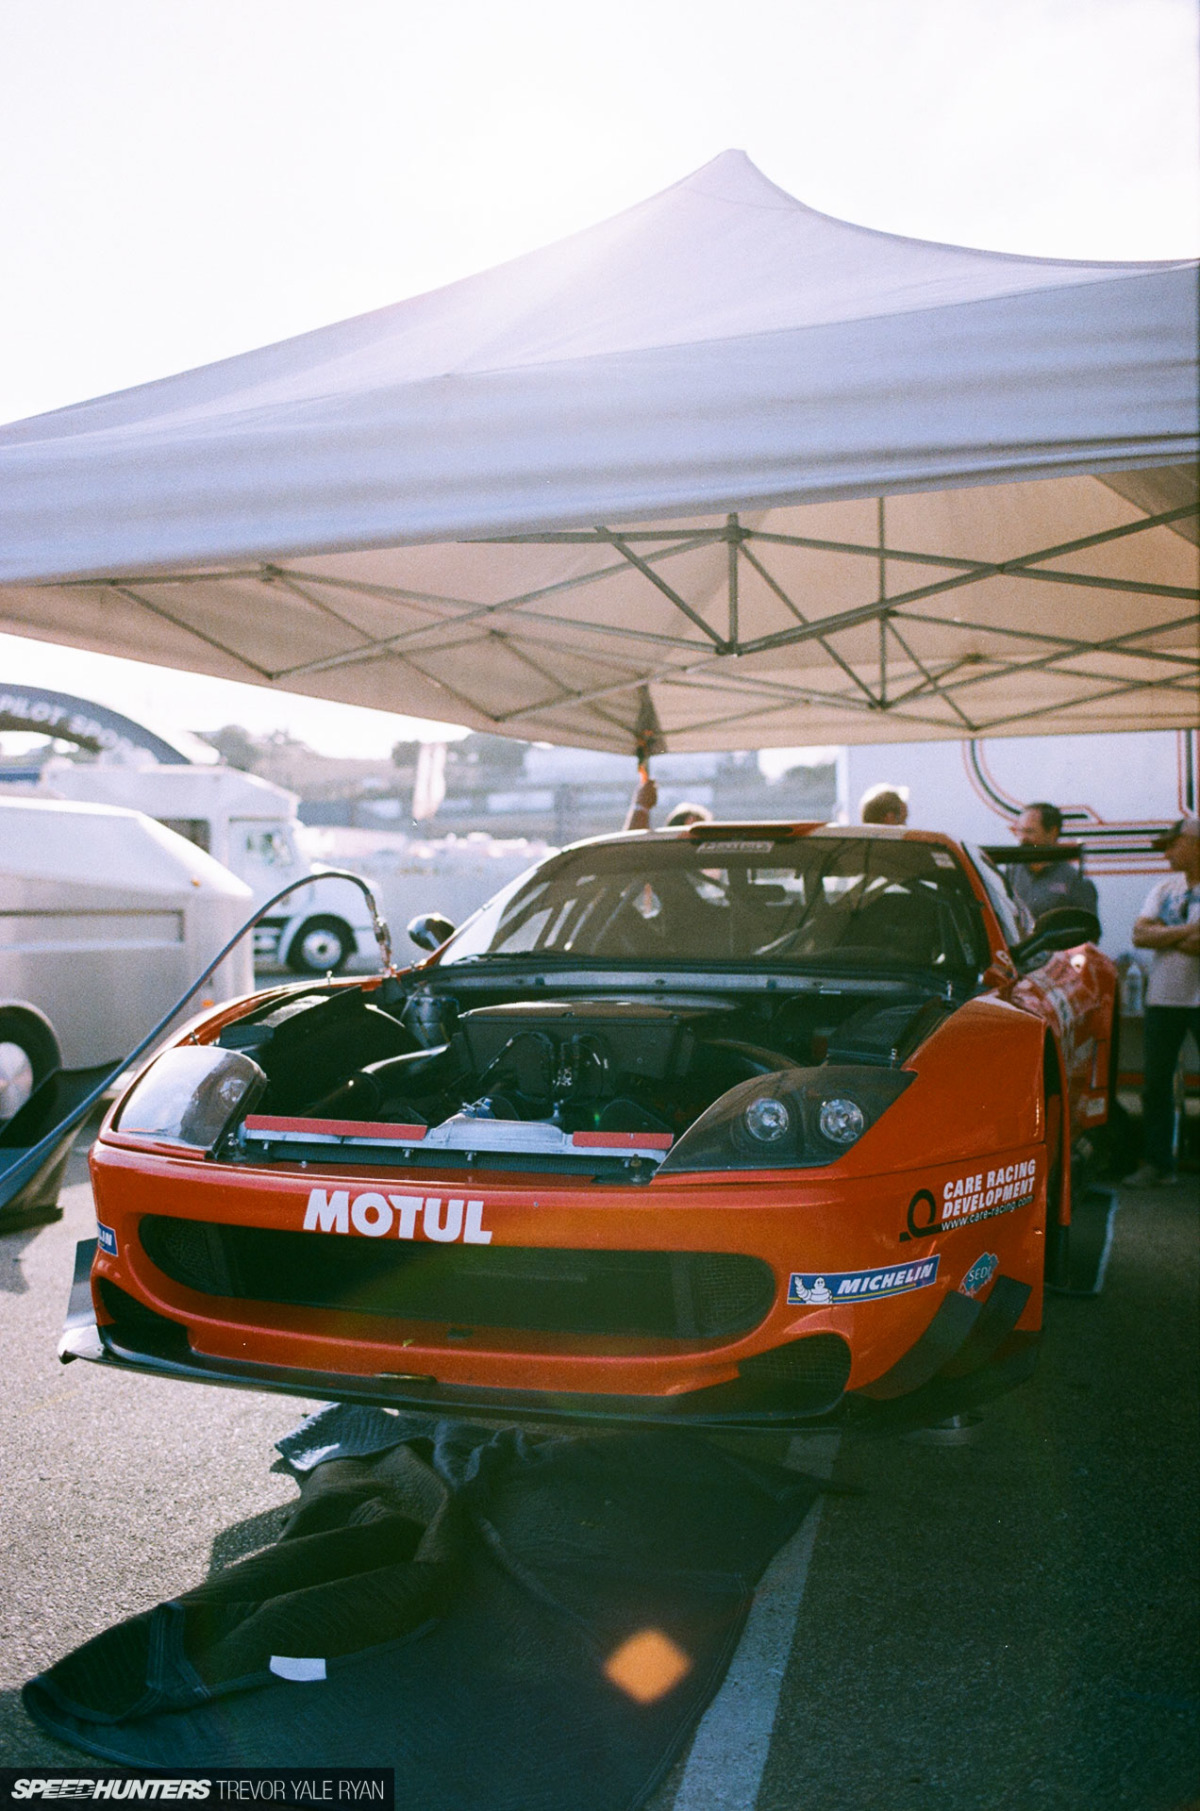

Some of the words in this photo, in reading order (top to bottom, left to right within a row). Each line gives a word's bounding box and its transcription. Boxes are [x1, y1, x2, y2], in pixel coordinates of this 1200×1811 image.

[942, 1176, 1036, 1220] DEVELOPMENT
[943, 1173, 983, 1200] CARE
[987, 1158, 1037, 1189] RACING
[302, 1188, 493, 1245] MOTUL
[941, 1195, 1035, 1232] www.care-racing.com
[836, 1262, 935, 1295] MICHELIN
